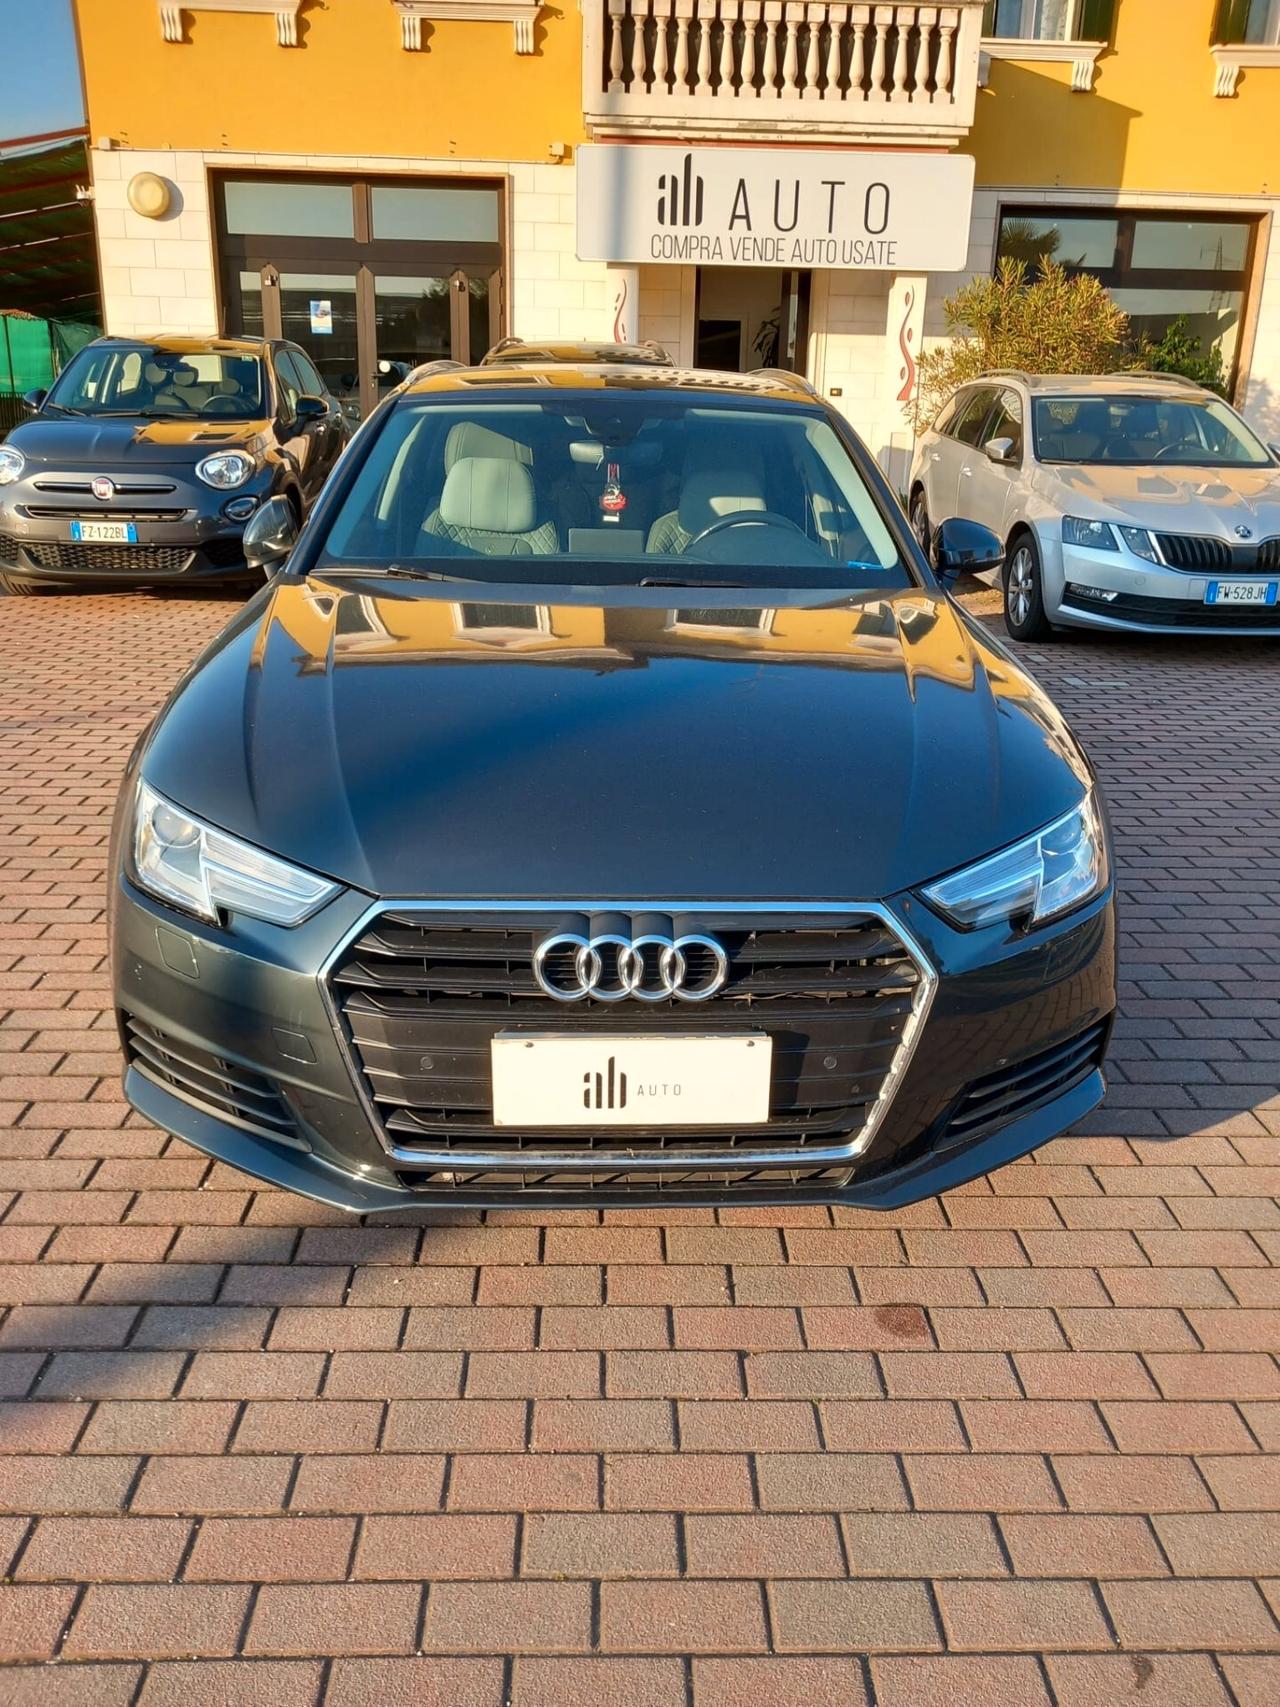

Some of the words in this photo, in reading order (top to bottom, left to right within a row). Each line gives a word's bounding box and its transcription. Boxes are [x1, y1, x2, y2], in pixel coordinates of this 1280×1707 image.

[728, 178, 890, 235] AUTO
[651, 234, 723, 260] COMPRA
[730, 237, 786, 262] VENDE
[791, 239, 838, 264] AUTO
[842, 240, 898, 265] USATE
[637, 1084, 682, 1096] AUTO
